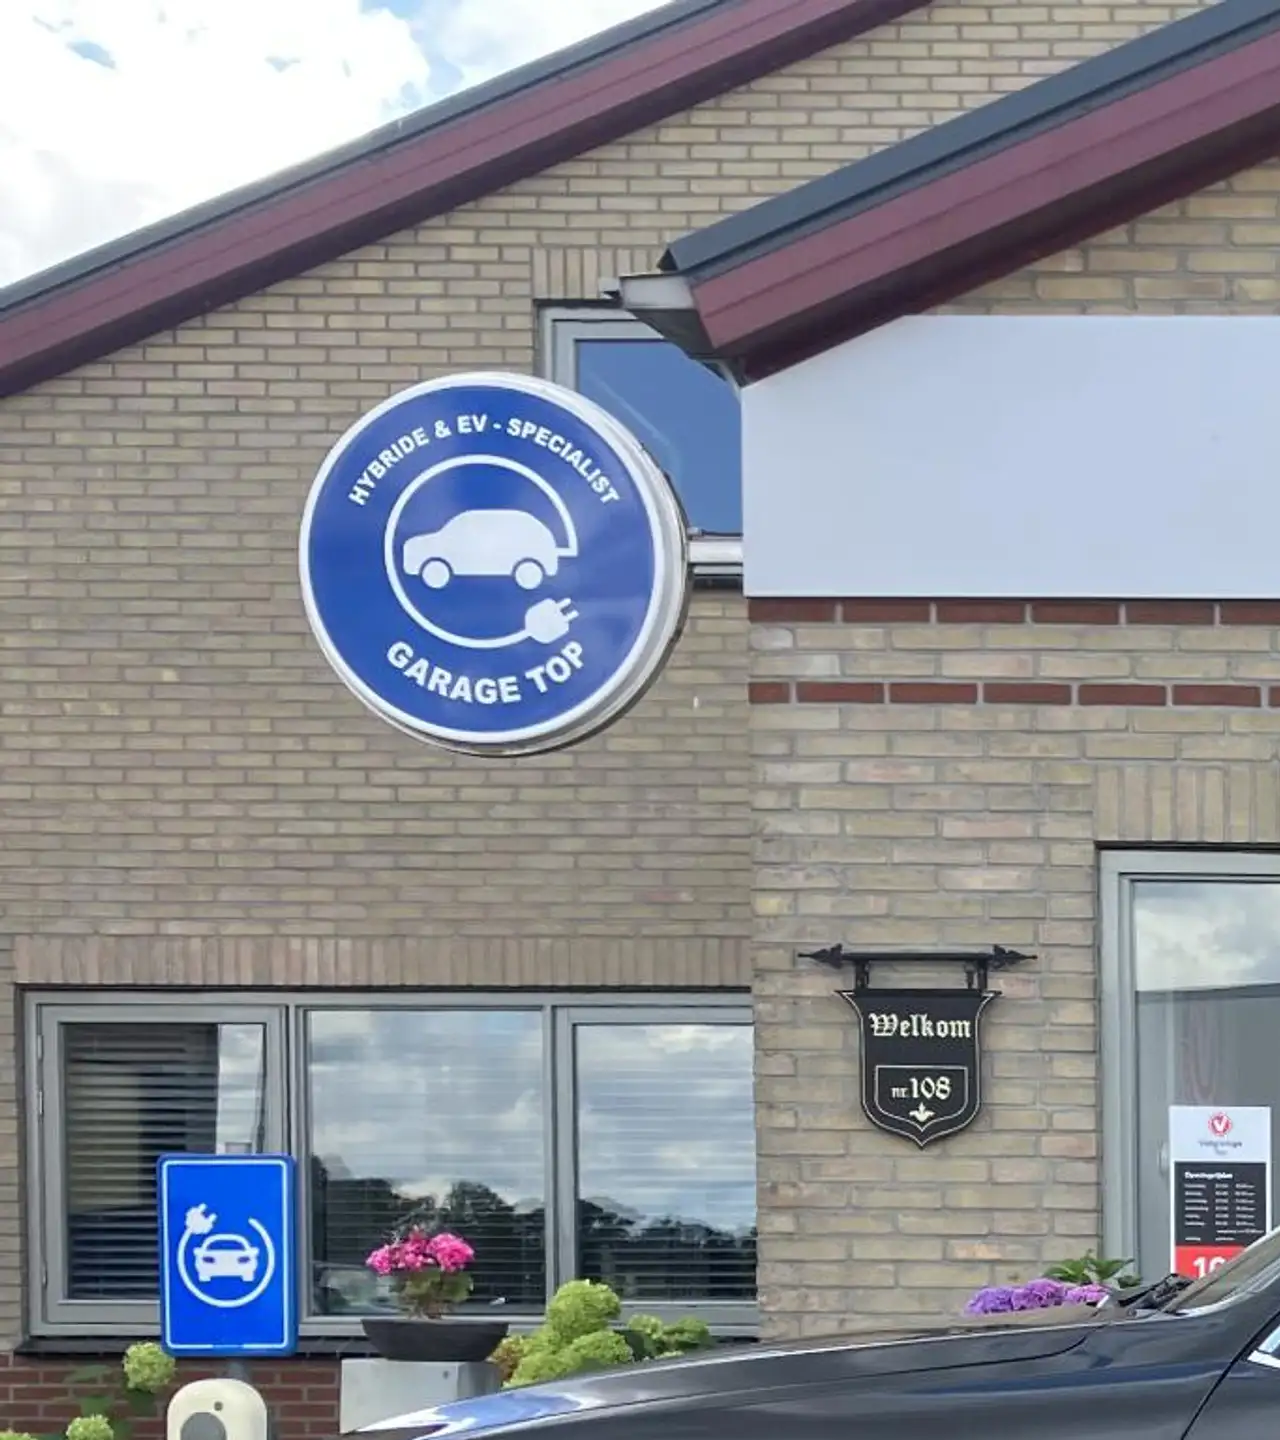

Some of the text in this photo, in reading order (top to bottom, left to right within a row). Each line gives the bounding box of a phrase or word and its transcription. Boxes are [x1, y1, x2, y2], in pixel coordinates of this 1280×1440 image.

[348, 427, 430, 505] HYBRIDE
[434, 419, 452, 439] &
[457, 414, 488, 434] EV
[506, 417, 621, 504] SPECIALIST
[386, 641, 585, 705] GARAGE TOP
[868, 1013, 972, 1038] Welkom
[909, 1076, 951, 1100] 108
